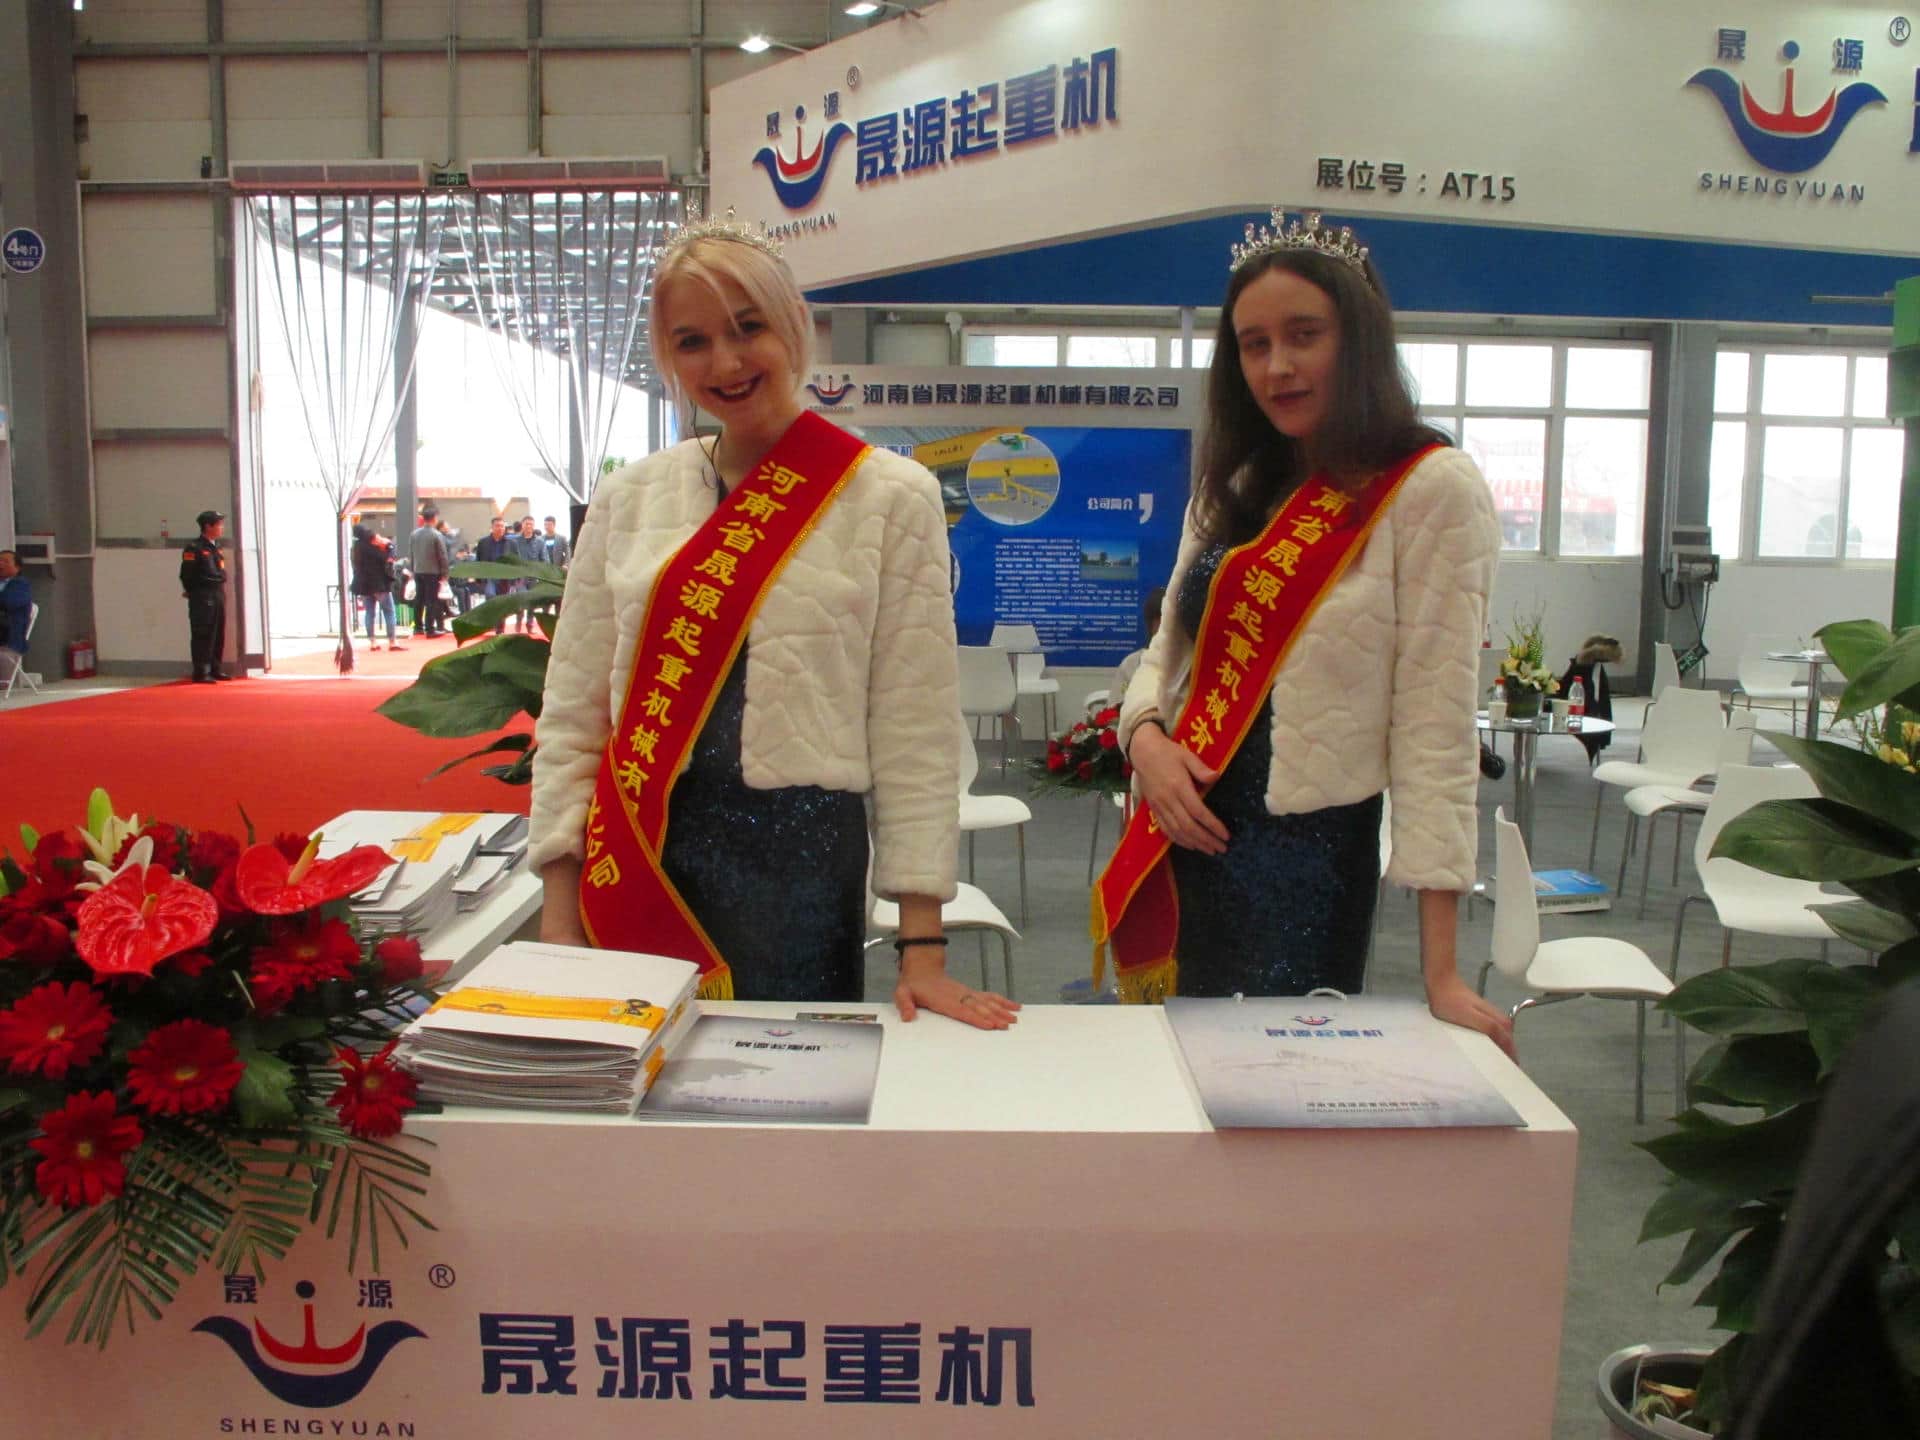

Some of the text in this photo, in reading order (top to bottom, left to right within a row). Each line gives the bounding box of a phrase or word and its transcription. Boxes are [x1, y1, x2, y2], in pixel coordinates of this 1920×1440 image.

[1836, 38, 1864, 70] 源
[855, 47, 1117, 184] 晟源起重机
[1701, 172, 1865, 201] SHENGYUAN
[762, 211, 837, 240] HENGYUAN
[863, 383, 1179, 408] 河南省晟源起重机械有限公司
[223, 1275, 393, 1309] 晟 源
[479, 1312, 1036, 1408] 晟源起重机
[219, 1417, 416, 1438] SHENGYUAN
